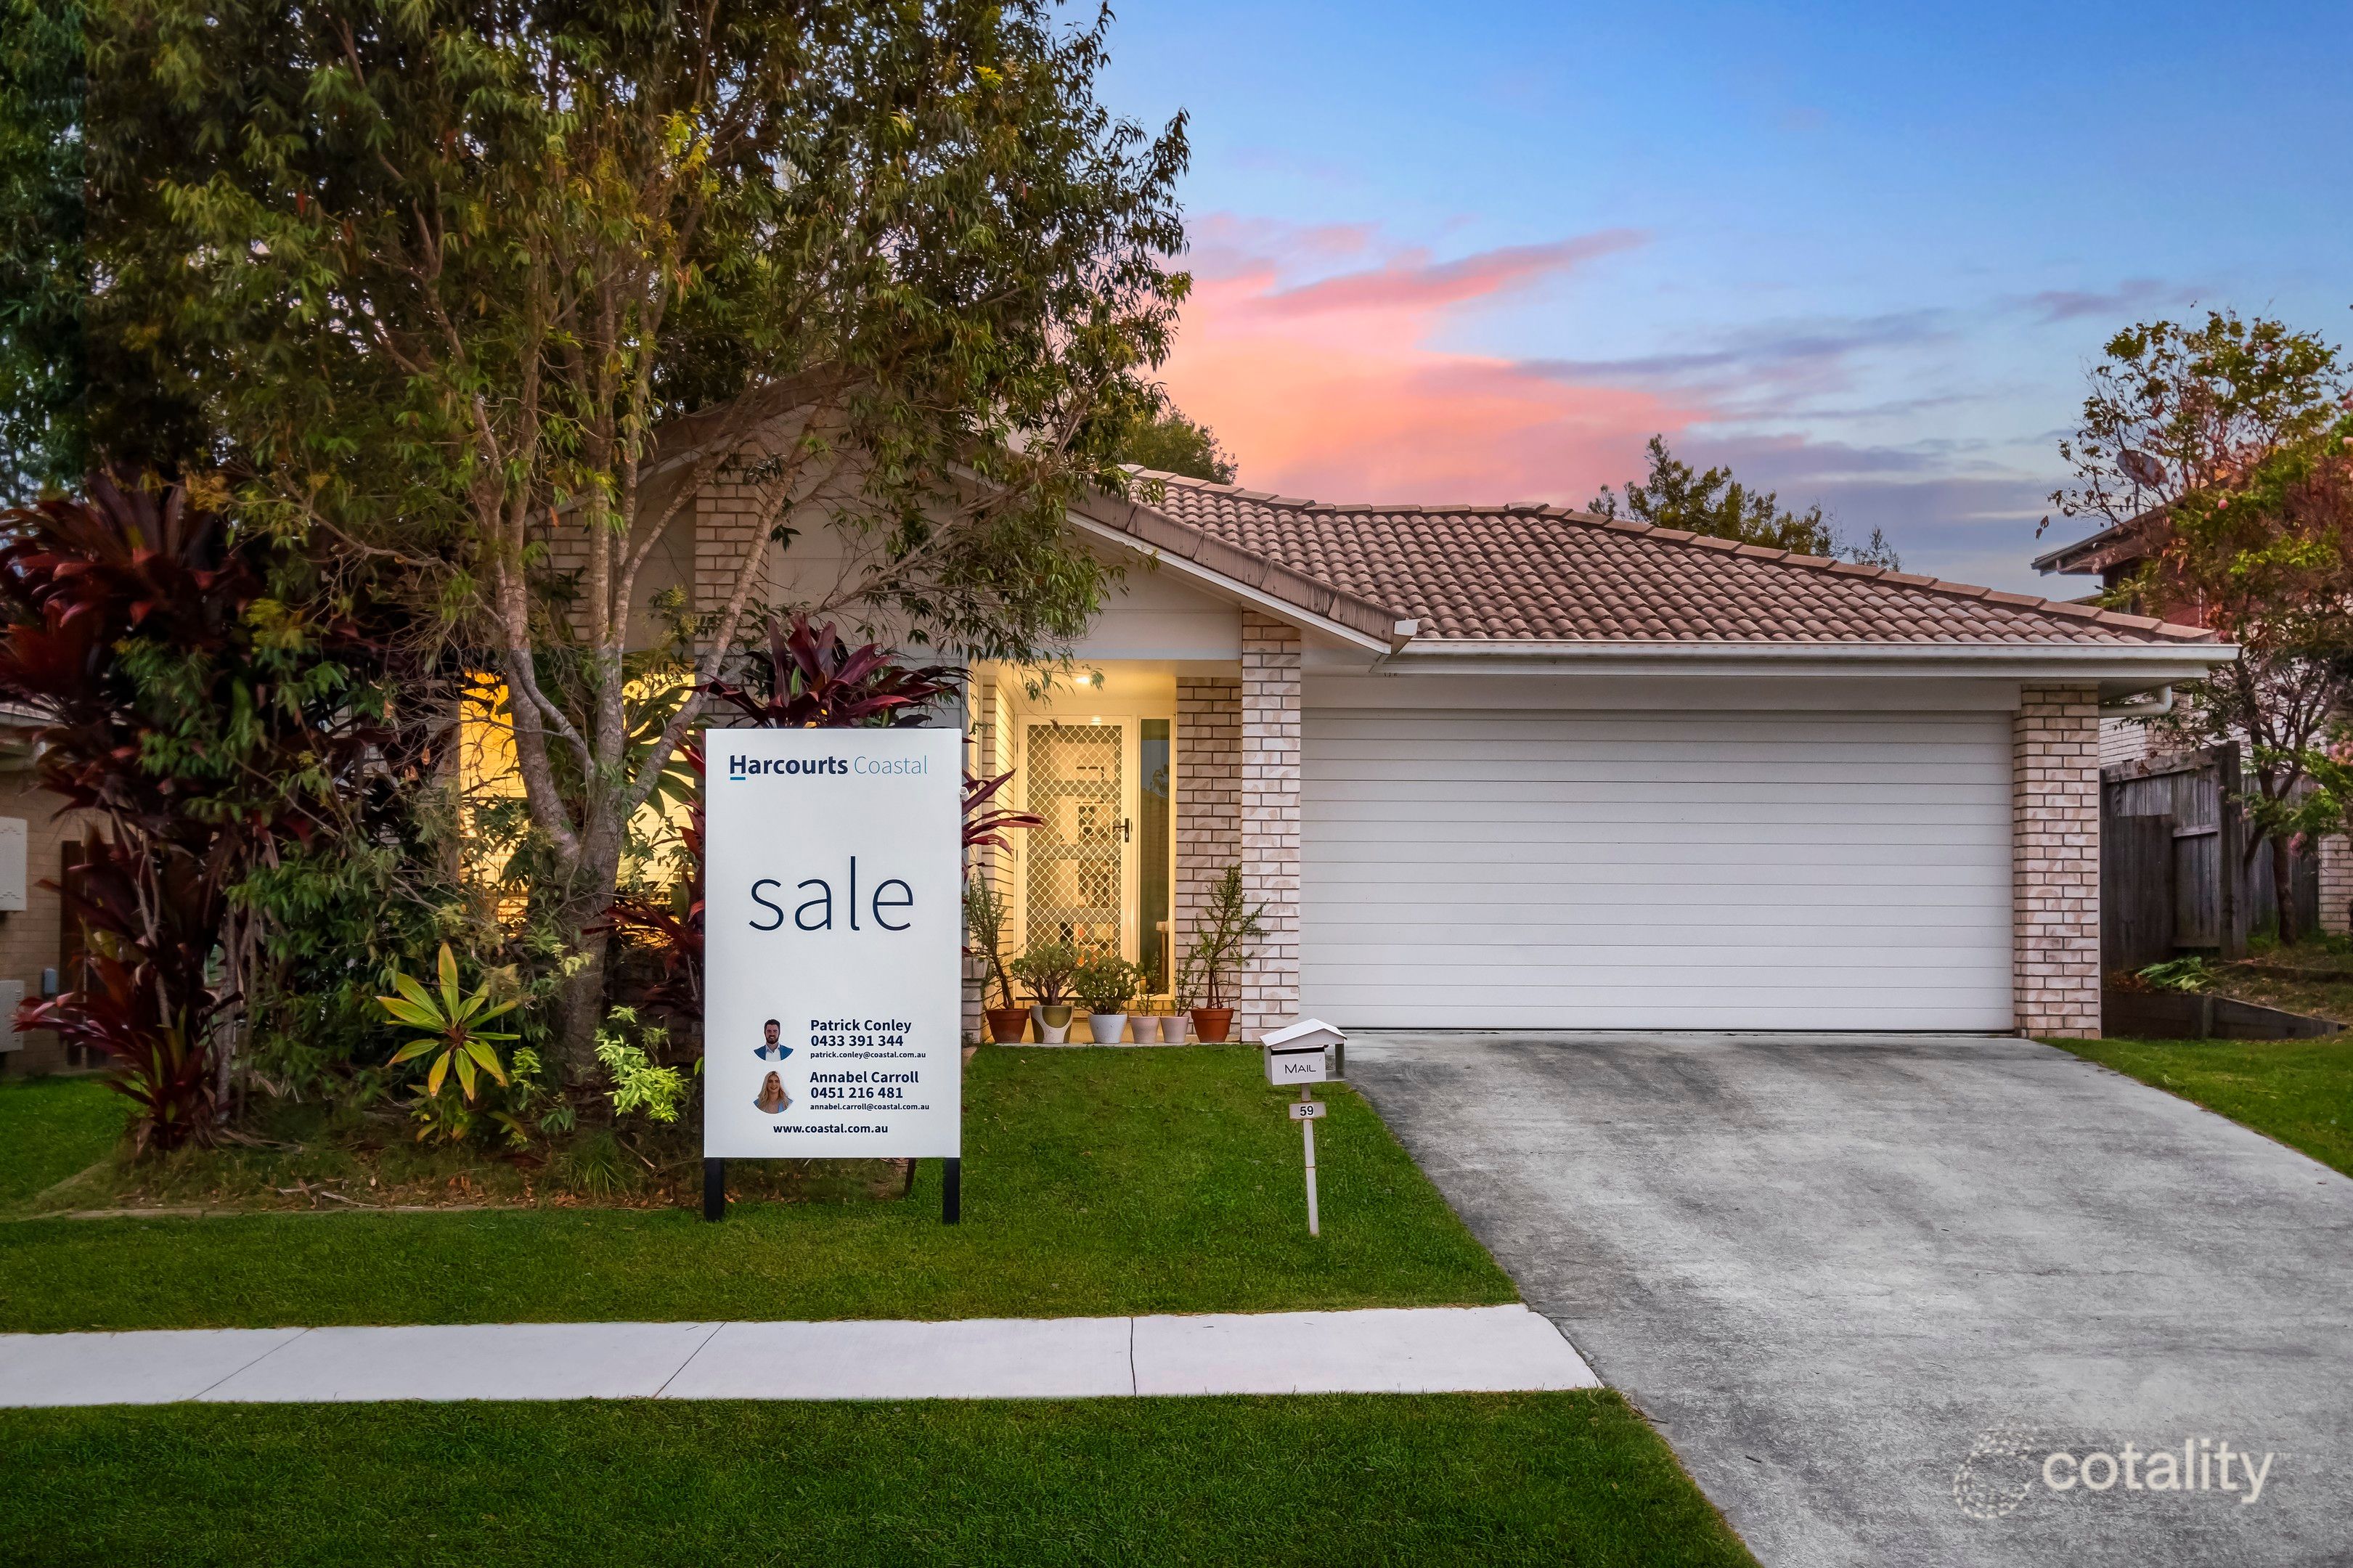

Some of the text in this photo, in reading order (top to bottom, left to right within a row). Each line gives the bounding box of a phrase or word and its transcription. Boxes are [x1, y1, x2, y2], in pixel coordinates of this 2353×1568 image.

[730, 755, 928, 775] Harcourts Coastal
[749, 856, 914, 931] sale
[810, 1019, 912, 1034] Patrick Conley
[810, 1035, 904, 1047] 0433 391 344
[1284, 1063, 1316, 1074] MAIL
[810, 1071, 919, 1083] Annabel Carroll
[810, 1087, 903, 1099] 0451 216 481
[810, 1103, 930, 1111] annabel.carroll@coastal.com.au
[1300, 1105, 1314, 1116] 59
[773, 1124, 889, 1134] www.coastal.com.au
